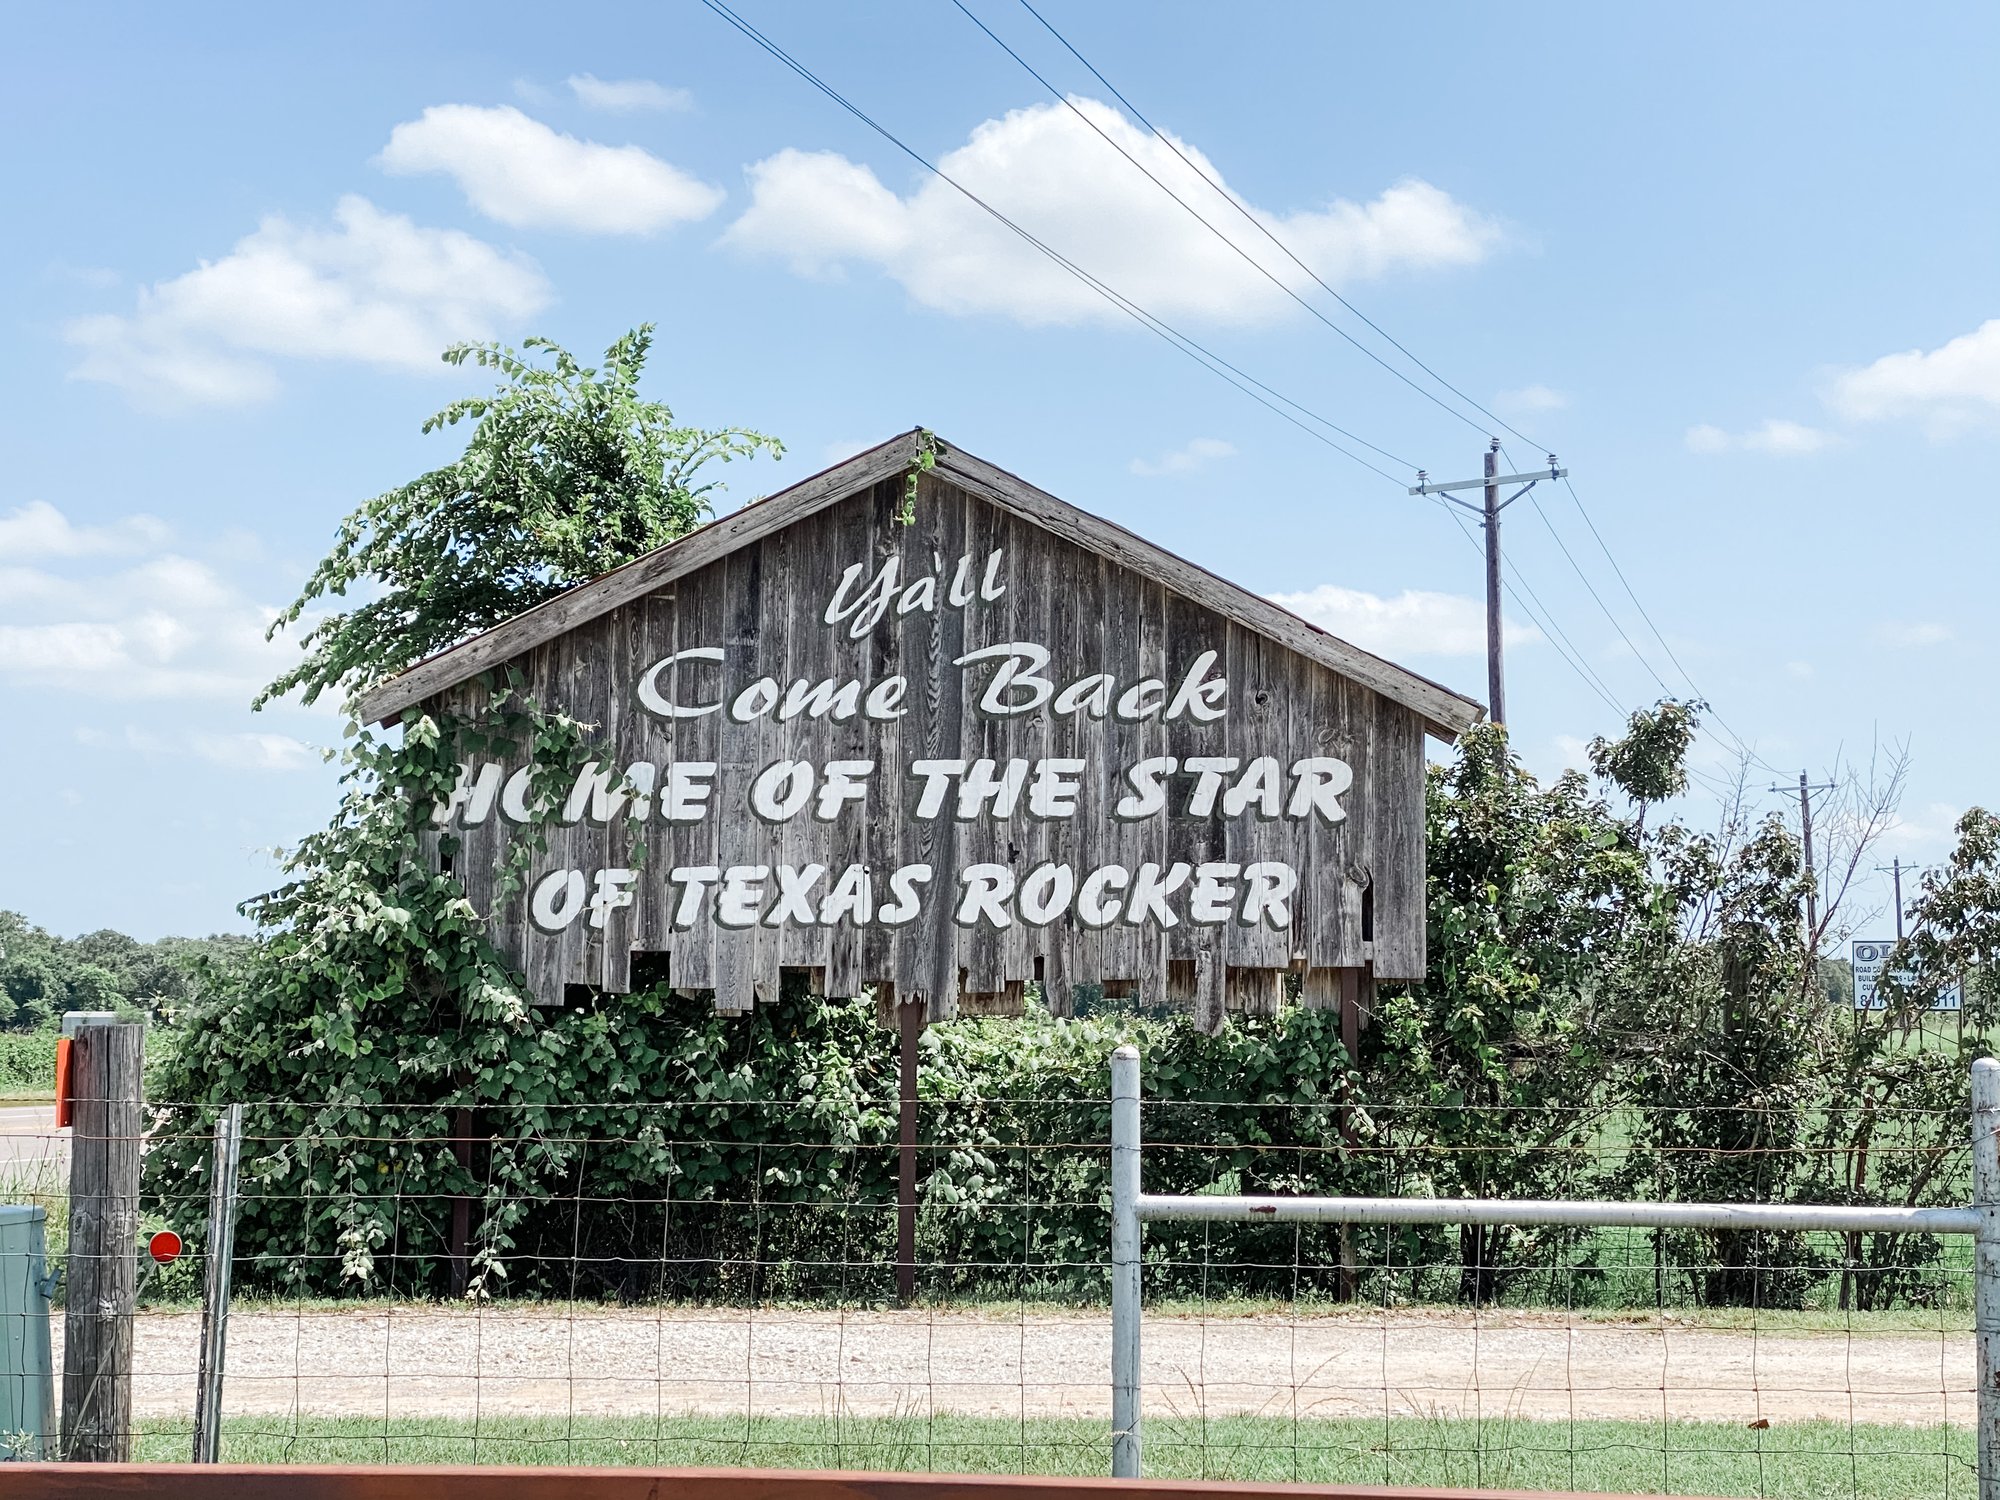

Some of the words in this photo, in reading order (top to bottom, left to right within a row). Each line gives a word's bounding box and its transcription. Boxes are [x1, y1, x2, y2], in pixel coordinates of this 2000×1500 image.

[637, 647, 908, 722] Come
[954, 642, 1228, 722] Back
[431, 760, 717, 825] HOME
[751, 759, 875, 824] OF
[911, 757, 1086, 821] THE
[1115, 756, 1354, 827] STAR
[531, 866, 638, 934] OF
[670, 864, 933, 931] TEXAS
[955, 862, 1298, 931] ROCKER
